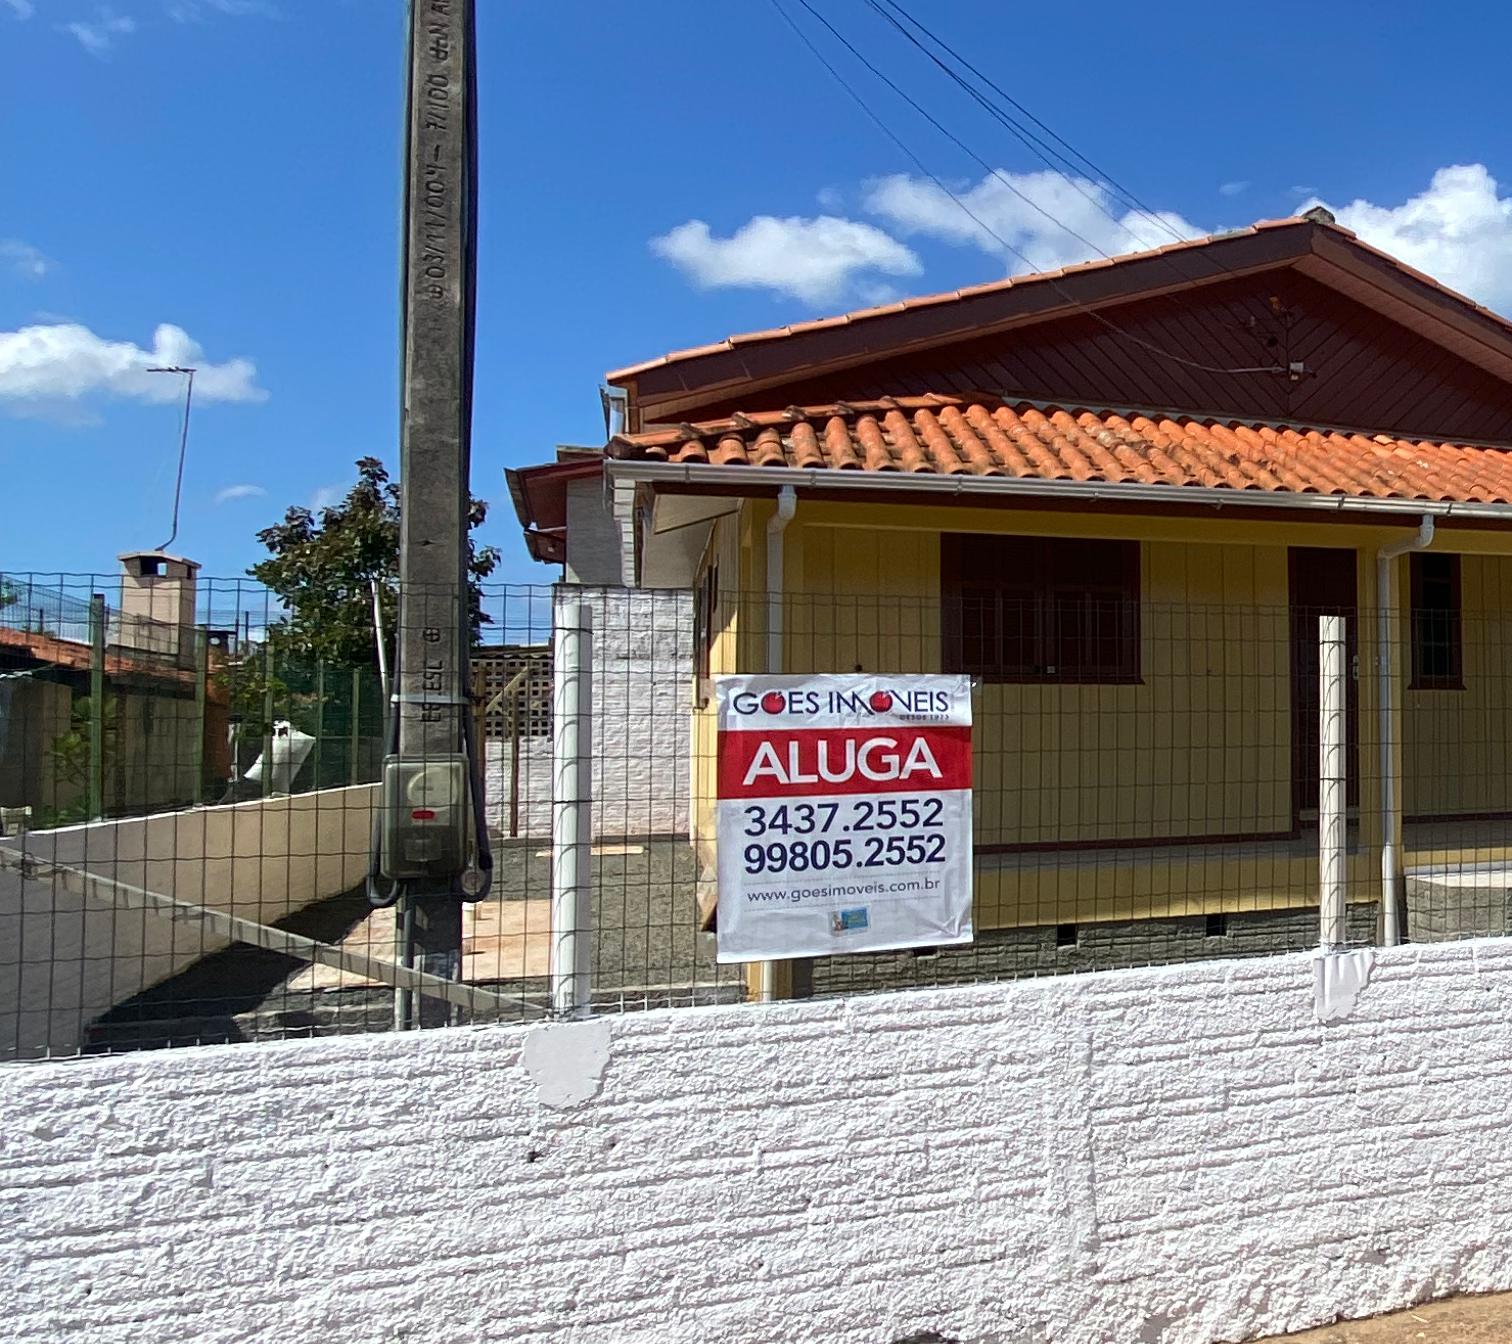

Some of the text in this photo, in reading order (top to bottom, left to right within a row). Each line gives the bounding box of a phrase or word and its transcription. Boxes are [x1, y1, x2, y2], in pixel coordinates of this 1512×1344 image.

[742, 737, 944, 786] ALUGA
[743, 798, 944, 837] 3437.2552
[743, 833, 947, 875] 99805.2552
[746, 876, 941, 903] www.goesimoveis.com.br
